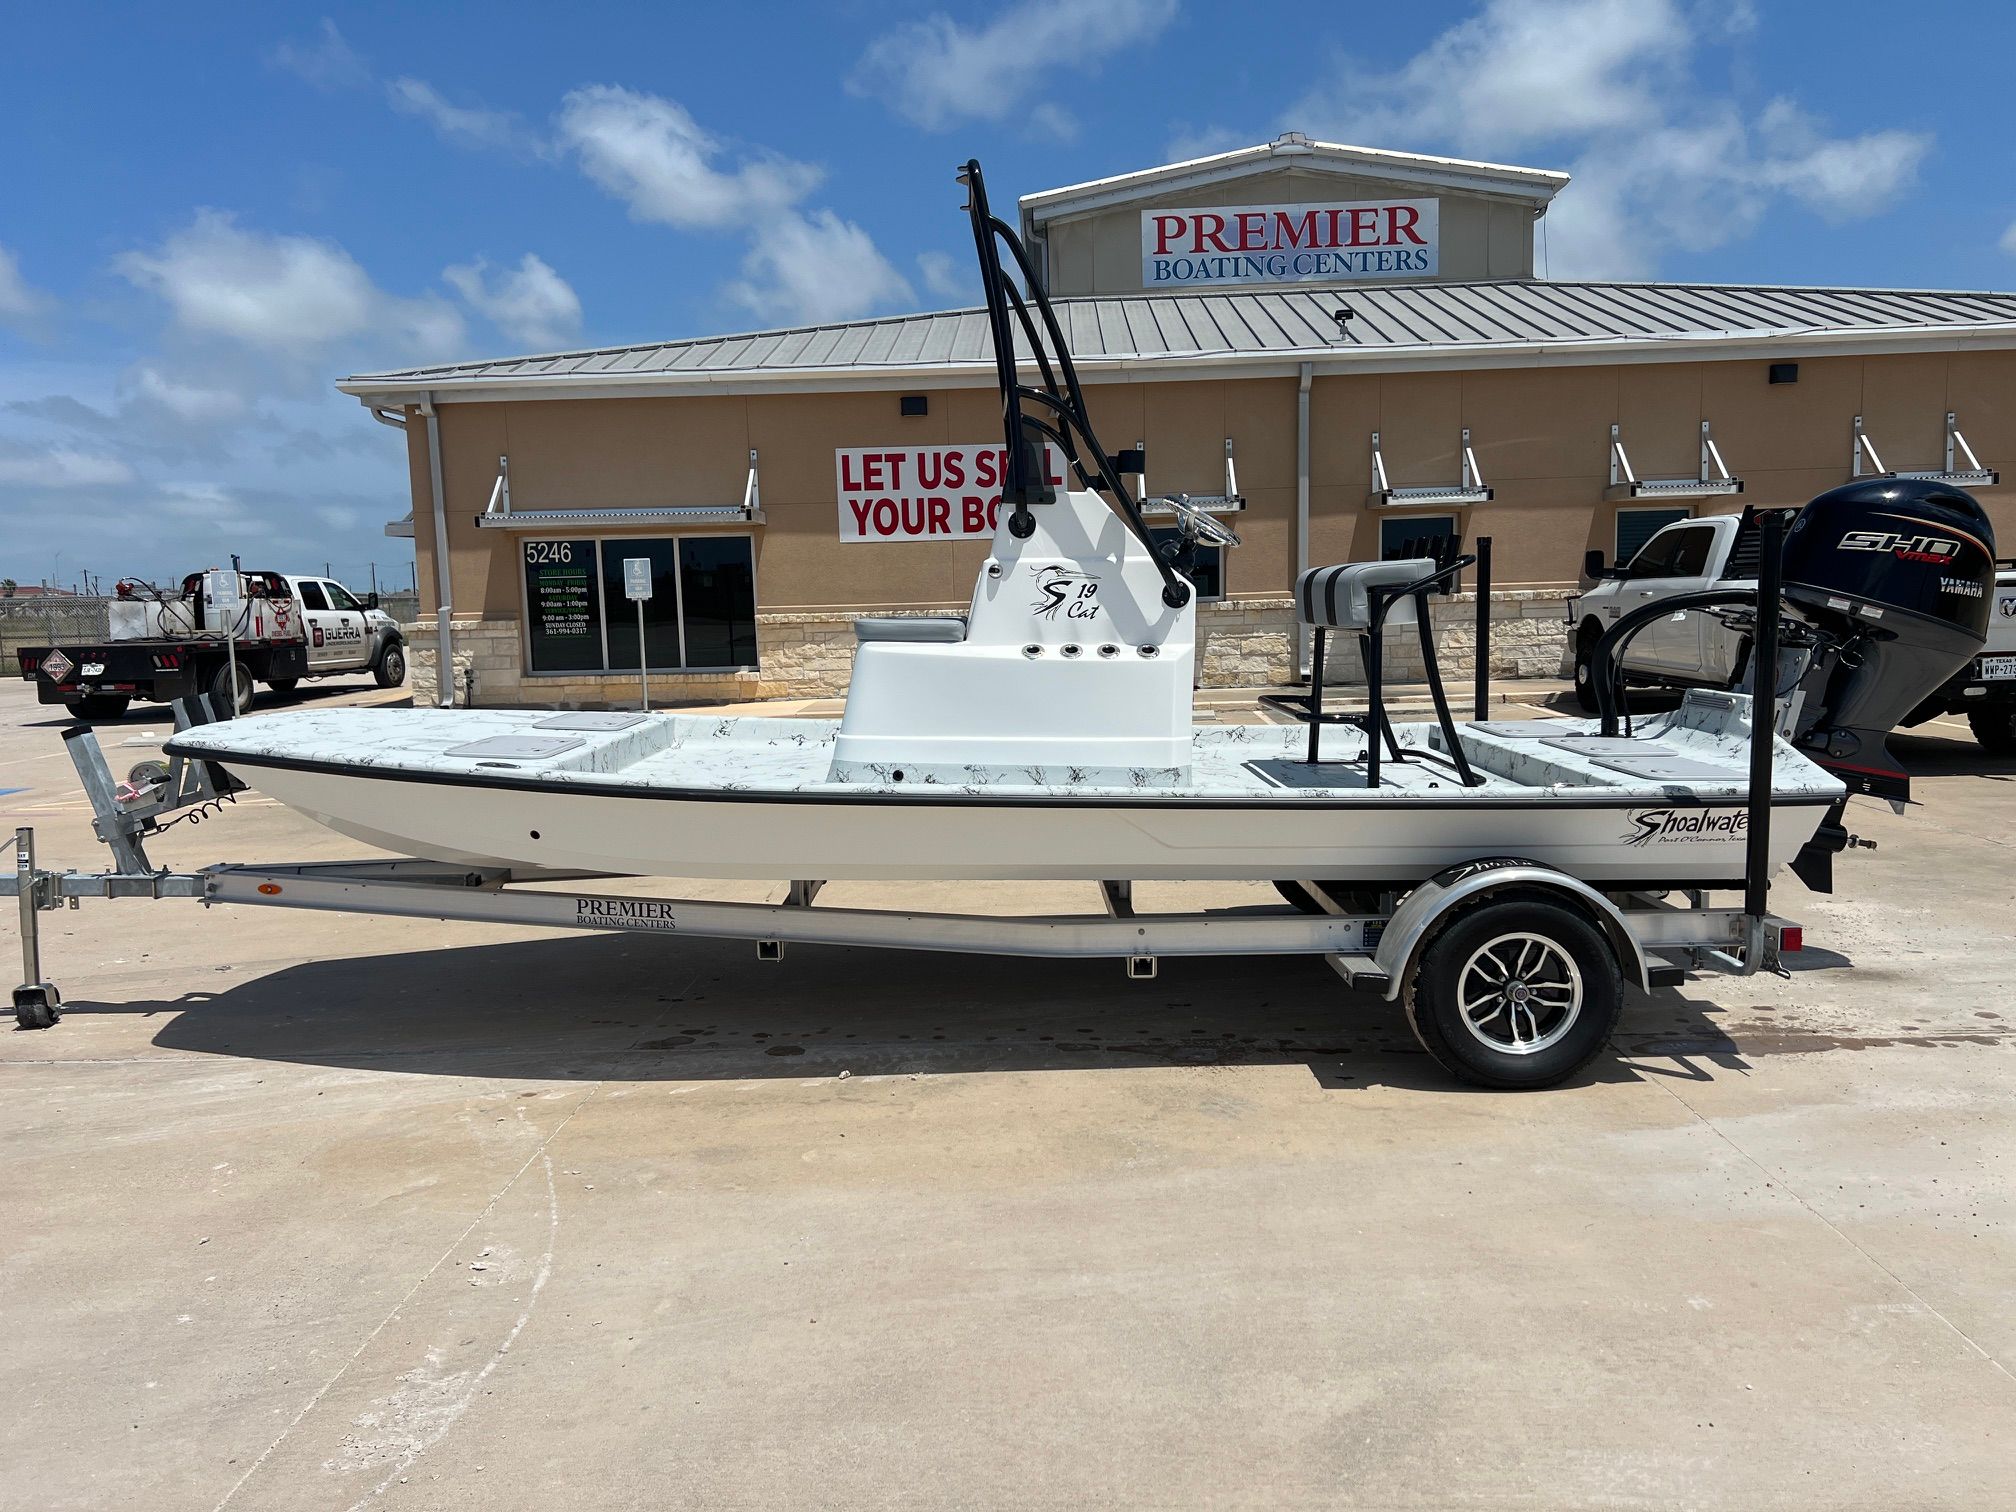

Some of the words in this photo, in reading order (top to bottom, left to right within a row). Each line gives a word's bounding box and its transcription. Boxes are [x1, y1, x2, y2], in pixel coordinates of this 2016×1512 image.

[1151, 206, 1428, 255] PREMIER
[1153, 254, 1287, 281] BOATING
[1293, 249, 1428, 276] CENTERS
[841, 453, 906, 491] LET
[917, 451, 965, 490] US
[848, 497, 951, 536] YOUR
[526, 542, 572, 563] 5246
[1837, 531, 1961, 556] SHO
[562, 568, 587, 576] HOURS
[565, 586, 588, 594] 5:00pm
[1077, 583, 1098, 598] 19
[1940, 577, 1983, 598] YAMAHA
[566, 600, 588, 608] 1:00pm
[1067, 601, 1099, 619] Cat
[325, 627, 361, 640] GUERRA
[545, 627, 587, 635] 361-994-0317
[1624, 809, 1748, 845] Shoalwate
[576, 898, 675, 920] PREMIER
[577, 915, 625, 927] BOATING
[626, 917, 676, 929] CENTERS
